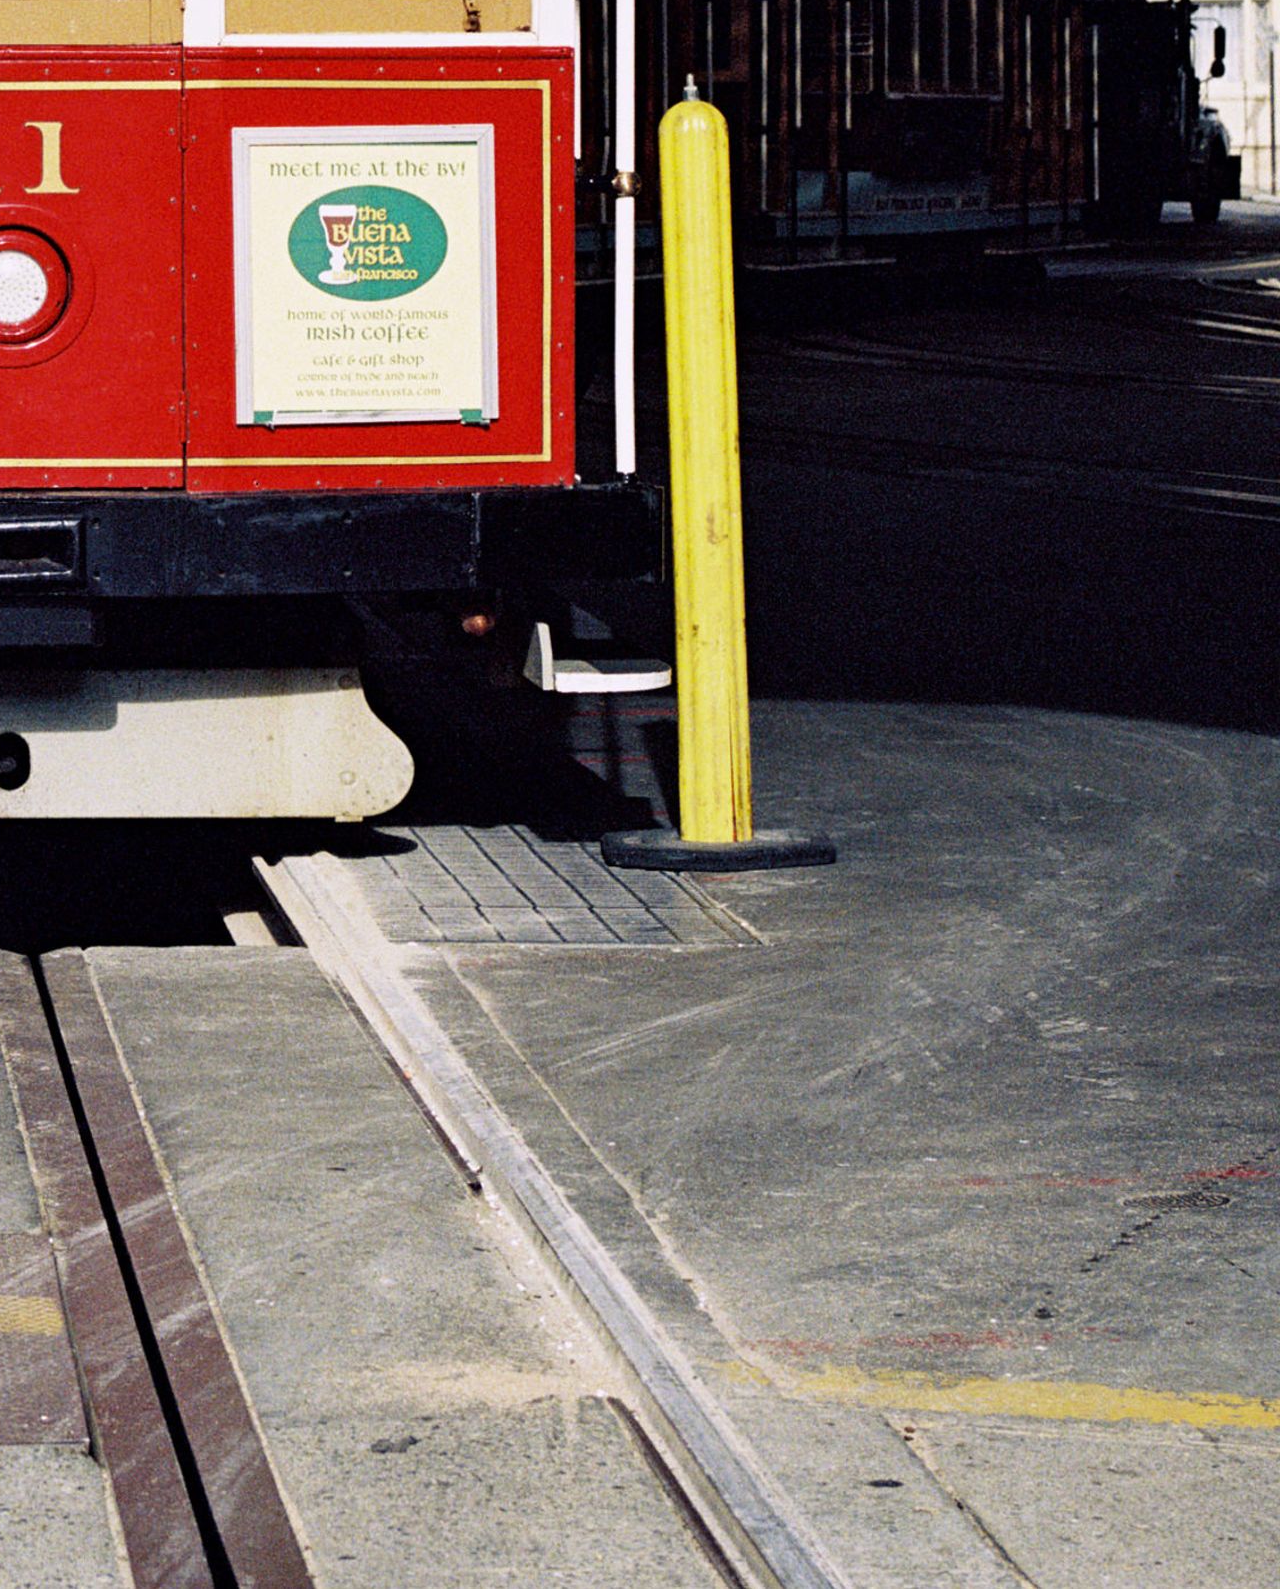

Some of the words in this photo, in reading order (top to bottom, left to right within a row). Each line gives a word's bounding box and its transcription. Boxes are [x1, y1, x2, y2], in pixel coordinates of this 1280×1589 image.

[269, 161, 323, 177] meet
[330, 162, 361, 177] me
[367, 161, 388, 177] at
[395, 159, 430, 177] the
[437, 161, 466, 177] BV!
[358, 205, 387, 222] the
[287, 310, 326, 321] home
[330, 309, 346, 322] of
[390, 353, 424, 368] shop
